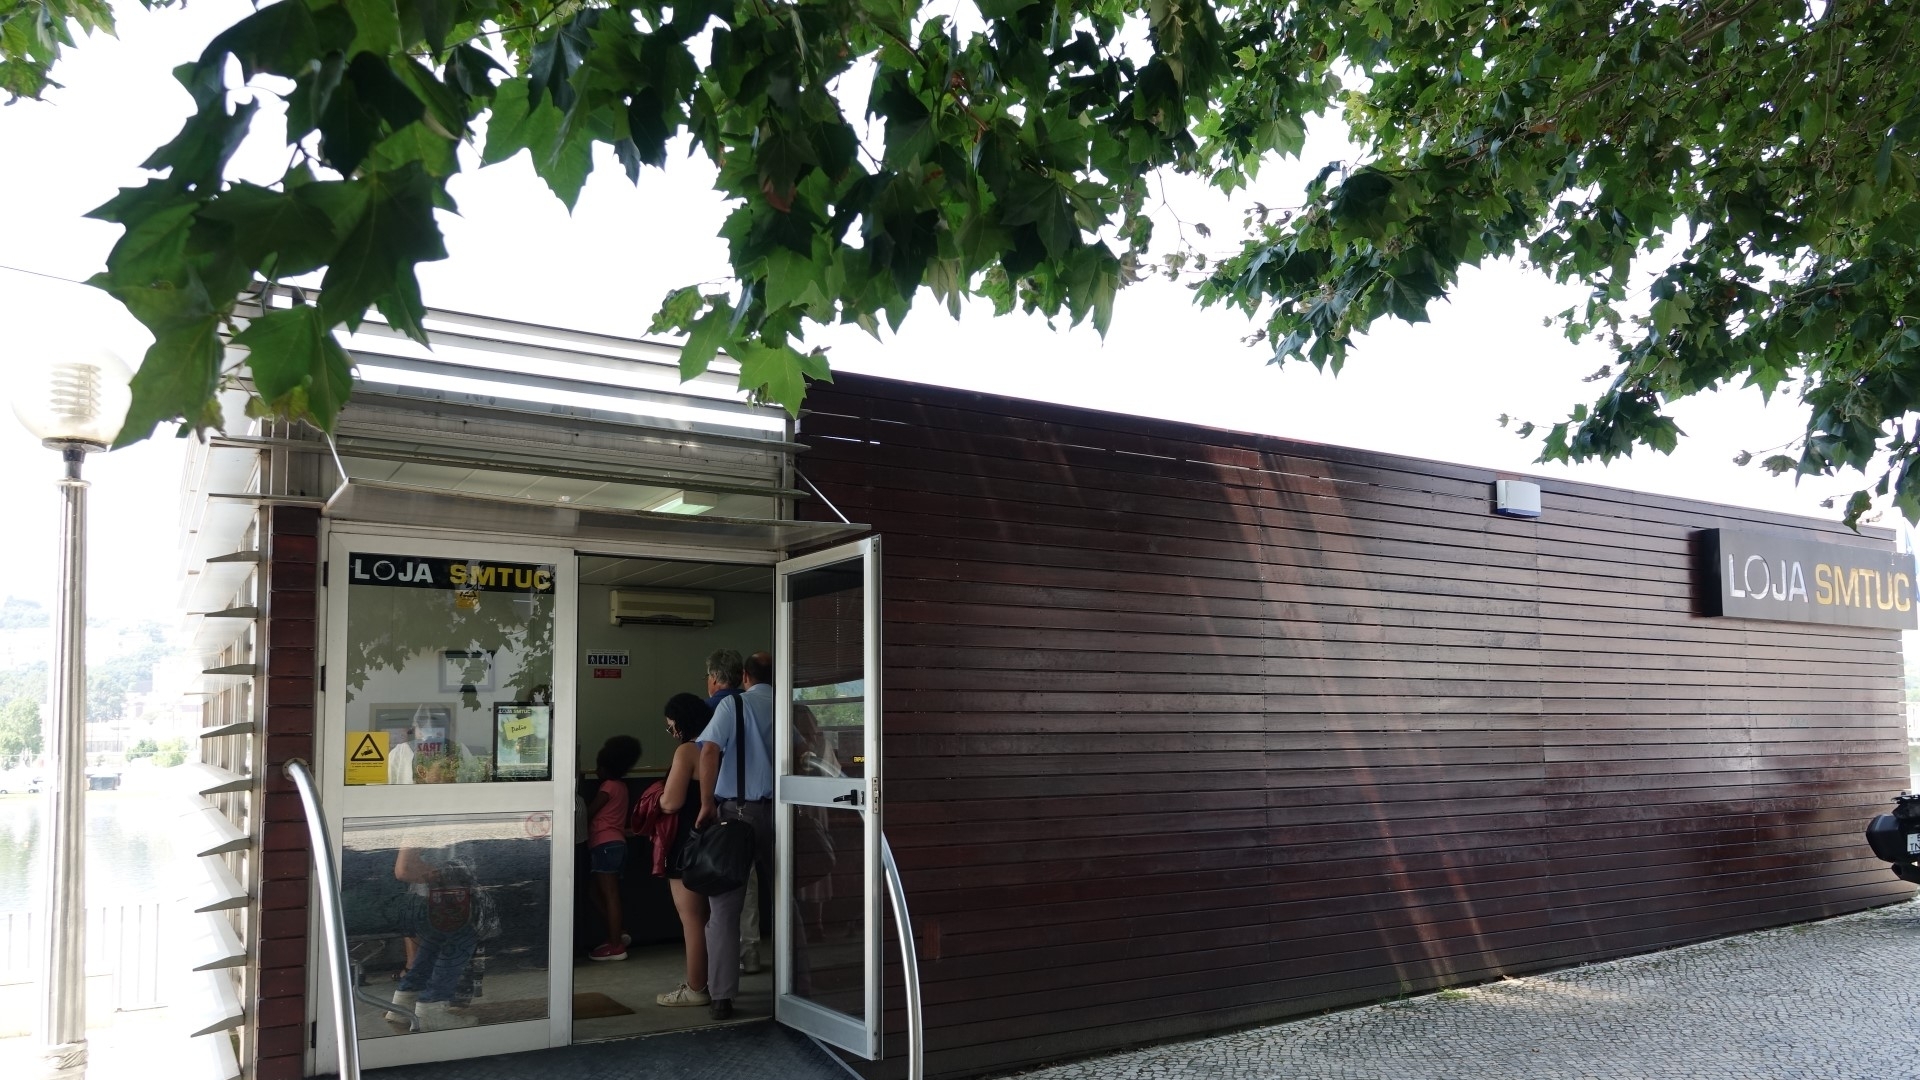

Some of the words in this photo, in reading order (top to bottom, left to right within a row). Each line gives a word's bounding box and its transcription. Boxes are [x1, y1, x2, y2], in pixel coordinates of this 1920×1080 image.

[354, 558, 434, 583] LOJA
[449, 563, 551, 590] SMTUC
[1728, 553, 1809, 602] LOJA
[1815, 563, 1911, 612] SMTUC
